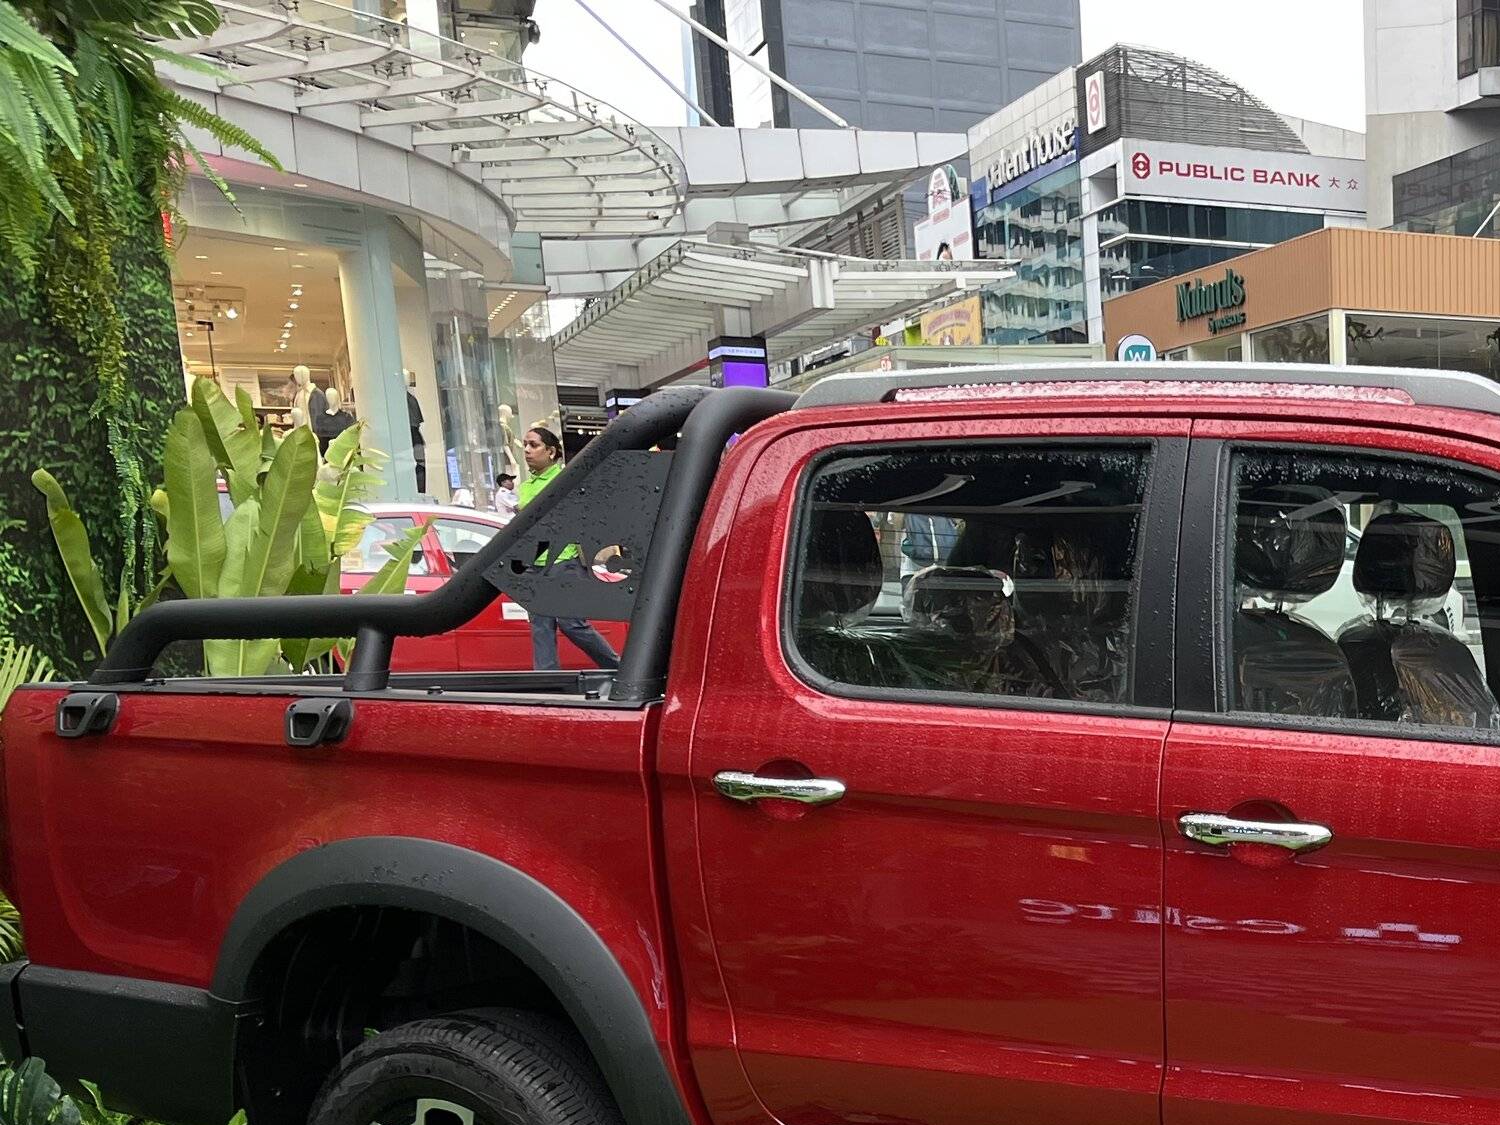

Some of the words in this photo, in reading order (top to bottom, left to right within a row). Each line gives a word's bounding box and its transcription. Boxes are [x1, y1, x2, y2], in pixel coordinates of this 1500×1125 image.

[1159, 161, 1245, 182] PUBLIC
[1253, 169, 1321, 188] BANK
[1176, 268, 1246, 322] Naturals
[511, 541, 632, 583] JAC
